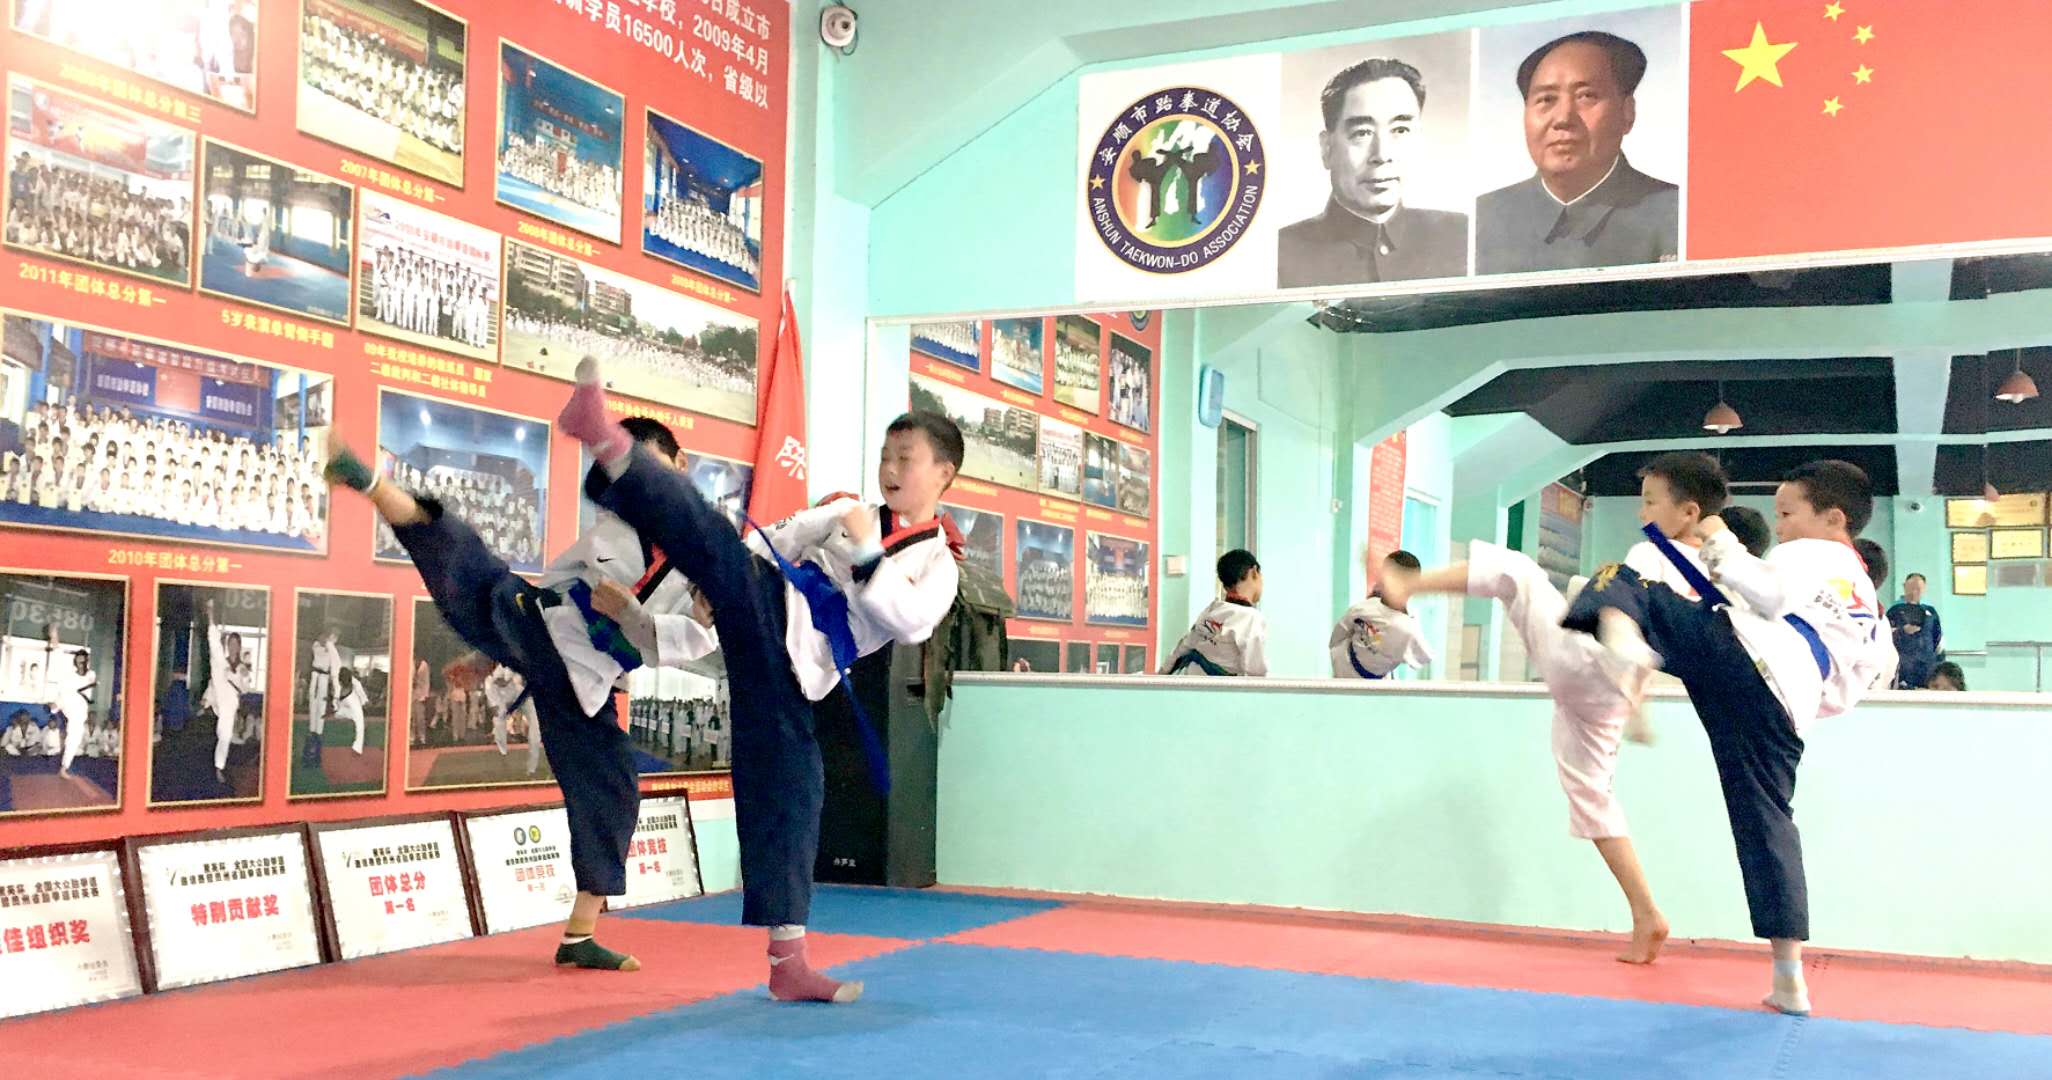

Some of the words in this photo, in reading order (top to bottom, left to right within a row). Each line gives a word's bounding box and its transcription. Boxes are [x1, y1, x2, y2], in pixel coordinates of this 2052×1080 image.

[703, 0, 771, 41] 日成立市
[1098, 89, 1255, 168] 安顺市跆拳道协会
[1093, 196, 1123, 245] ANSHUN
[1120, 241, 1199, 269] TAEKWON-DO
[1203, 184, 1259, 259] ASSOCIATION
[19, 262, 167, 307] 2011年团体总分第一
[108, 549, 243, 573] 2010年团体总分第一
[368, 870, 426, 897] 团体总分
[639, 860, 661, 874] 第一名
[190, 894, 280, 927] 特别贡献奖
[384, 897, 415, 914] 第一名
[0, 919, 91, 953] 佳组织奖
